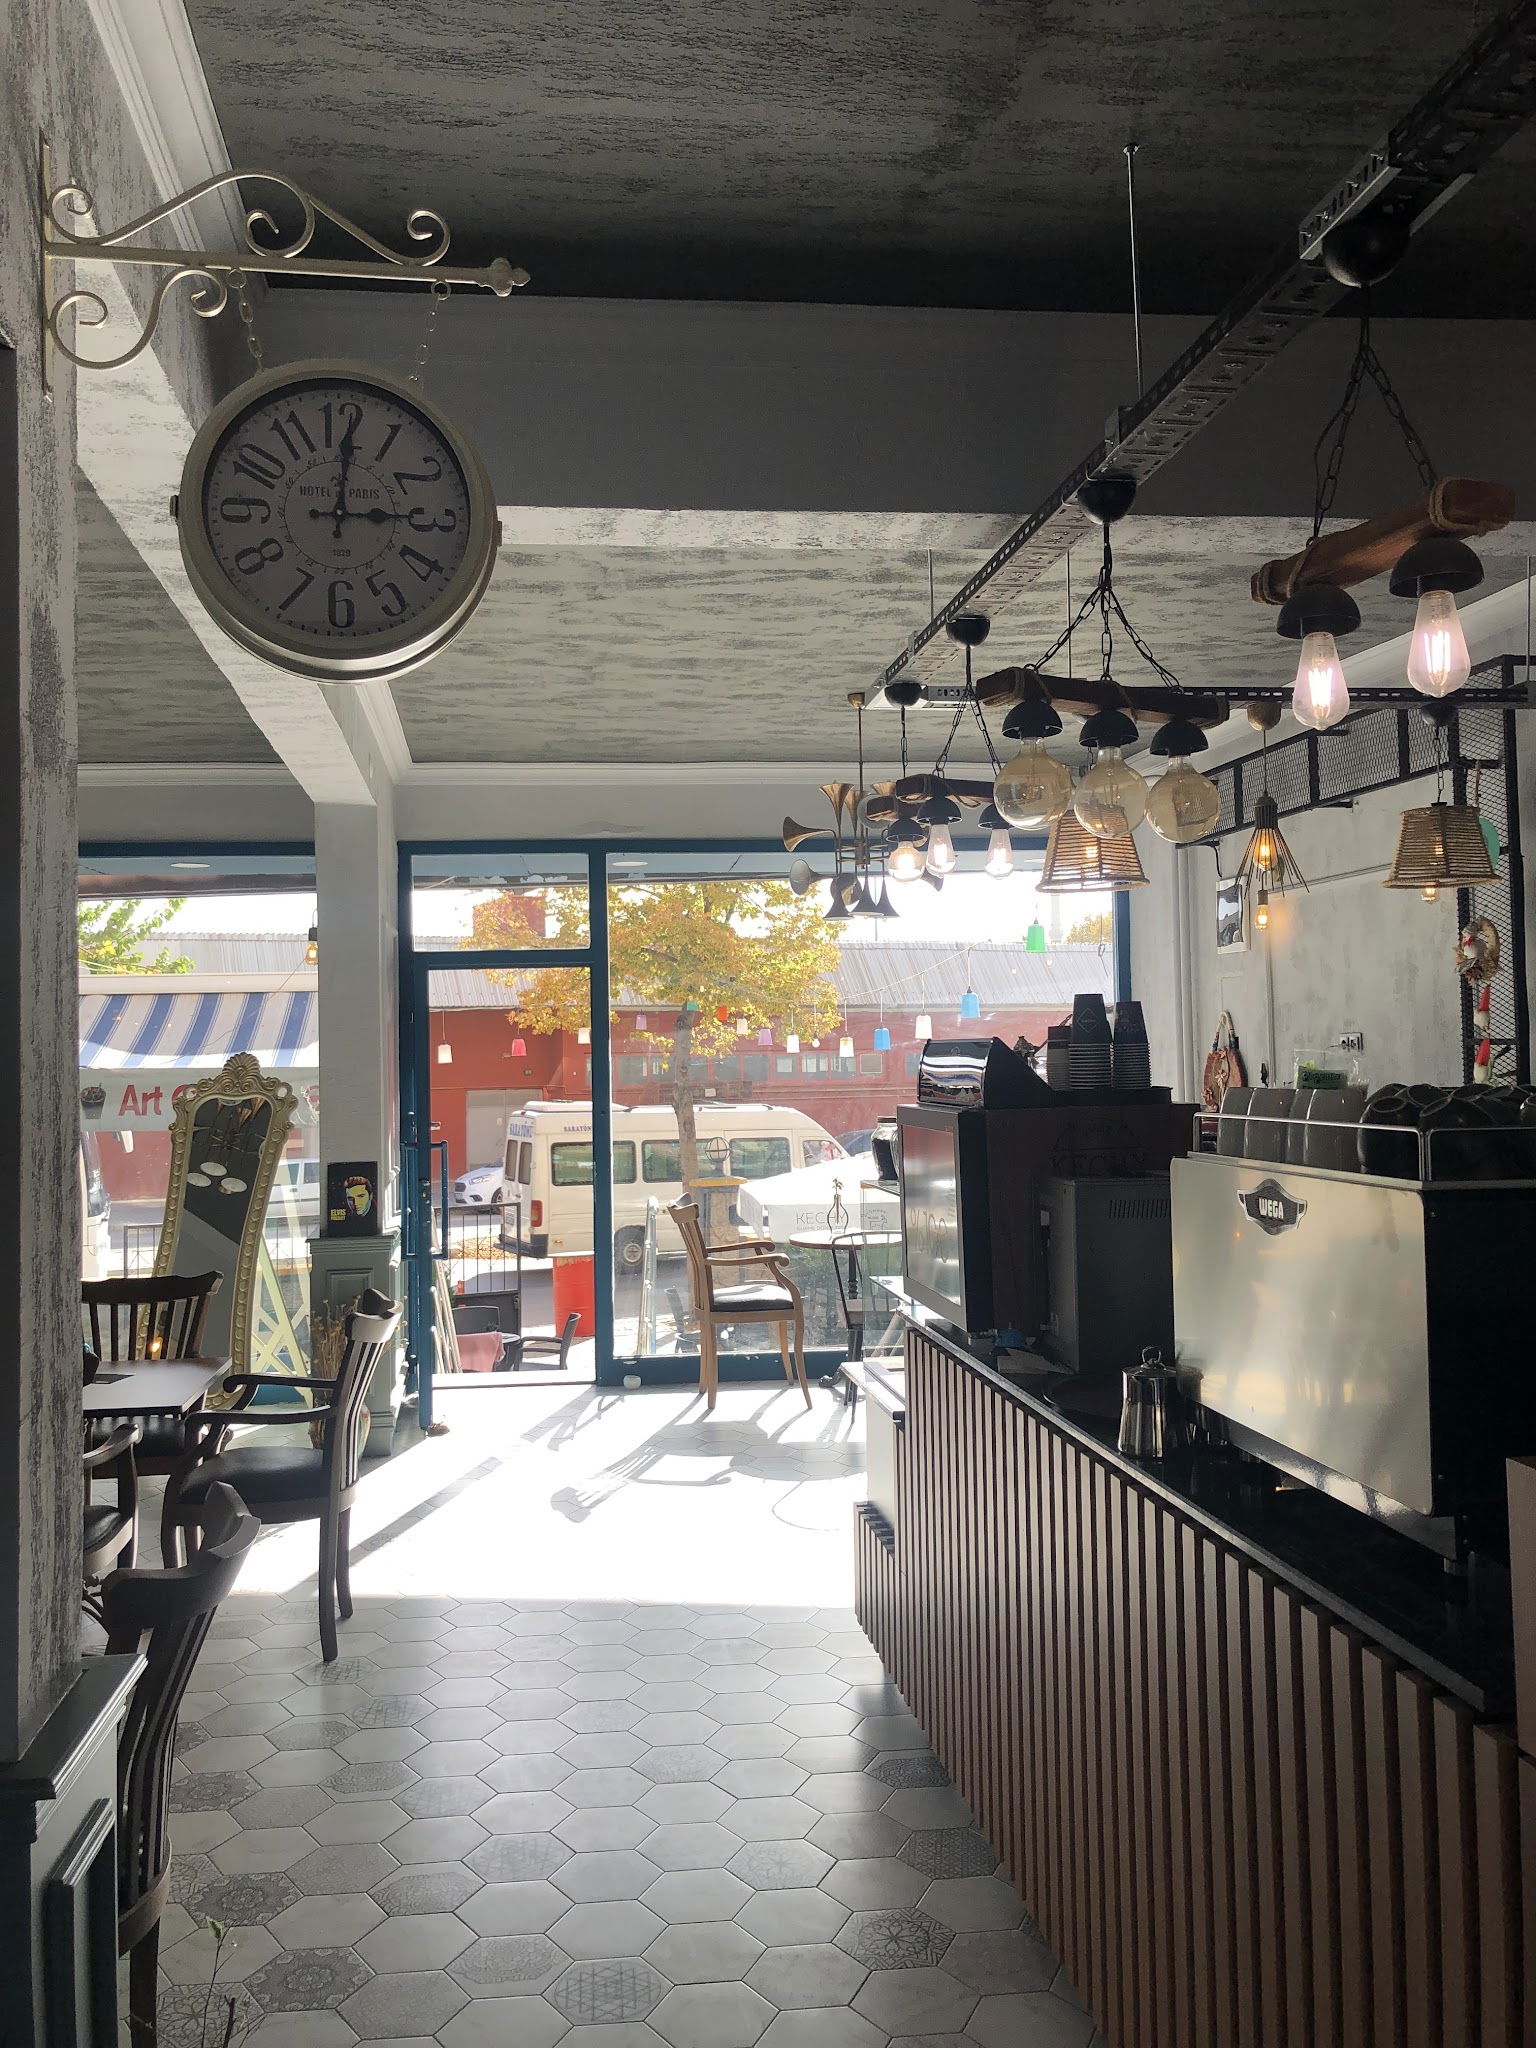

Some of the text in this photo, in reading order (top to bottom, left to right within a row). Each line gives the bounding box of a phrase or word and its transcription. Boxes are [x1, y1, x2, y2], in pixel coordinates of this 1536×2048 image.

[269, 410, 317, 460] 11
[319, 402, 363, 449] 12
[376, 424, 402, 461] 1
[233, 443, 286, 490] 10
[393, 456, 441, 495] 2
[220, 497, 272, 524] 9
[299, 486, 332, 498] HOTEL
[349, 488, 380, 499] PARIS
[408, 507, 457, 533] 3
[234, 538, 284, 575] 8
[399, 544, 444, 582] 4
[279, 567, 315, 610] 7
[327, 580, 355, 628] 6
[366, 570, 407, 616] 5
[118, 1084, 163, 1116] Art
[1258, 1197, 1284, 1219] WEGA
